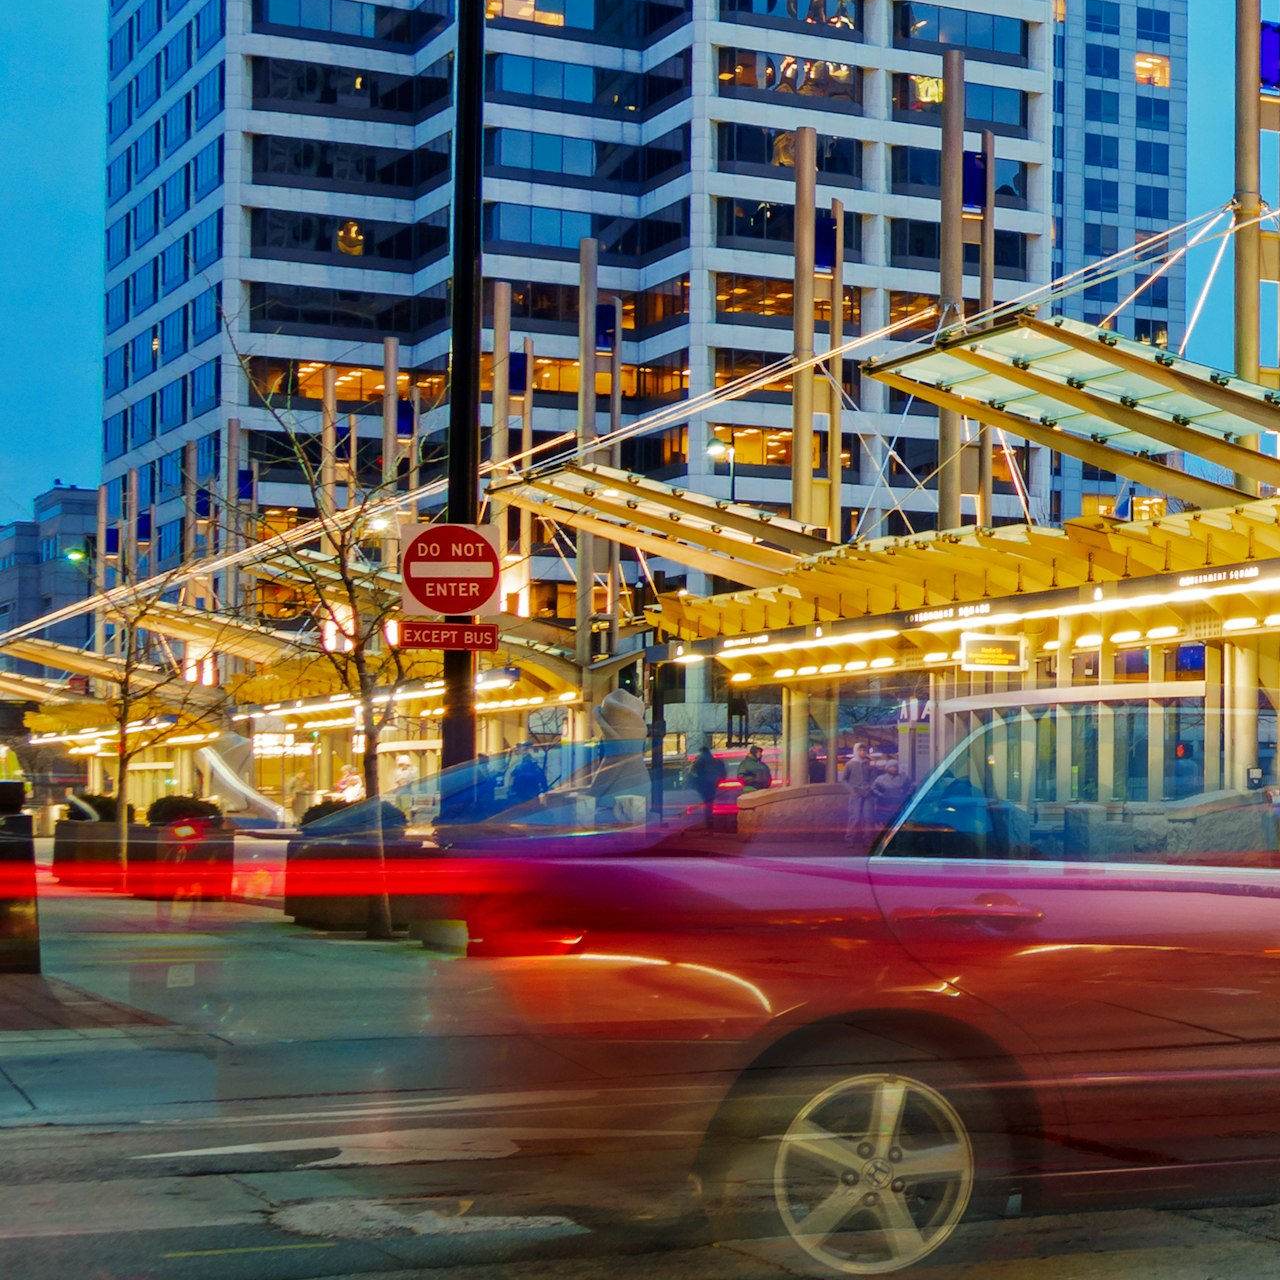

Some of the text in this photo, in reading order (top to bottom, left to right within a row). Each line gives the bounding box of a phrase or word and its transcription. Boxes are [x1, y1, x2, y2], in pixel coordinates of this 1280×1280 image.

[417, 542, 485, 557] DO NOT
[425, 582, 480, 597] ENTER
[403, 629, 493, 645] EXCEPT BUS
